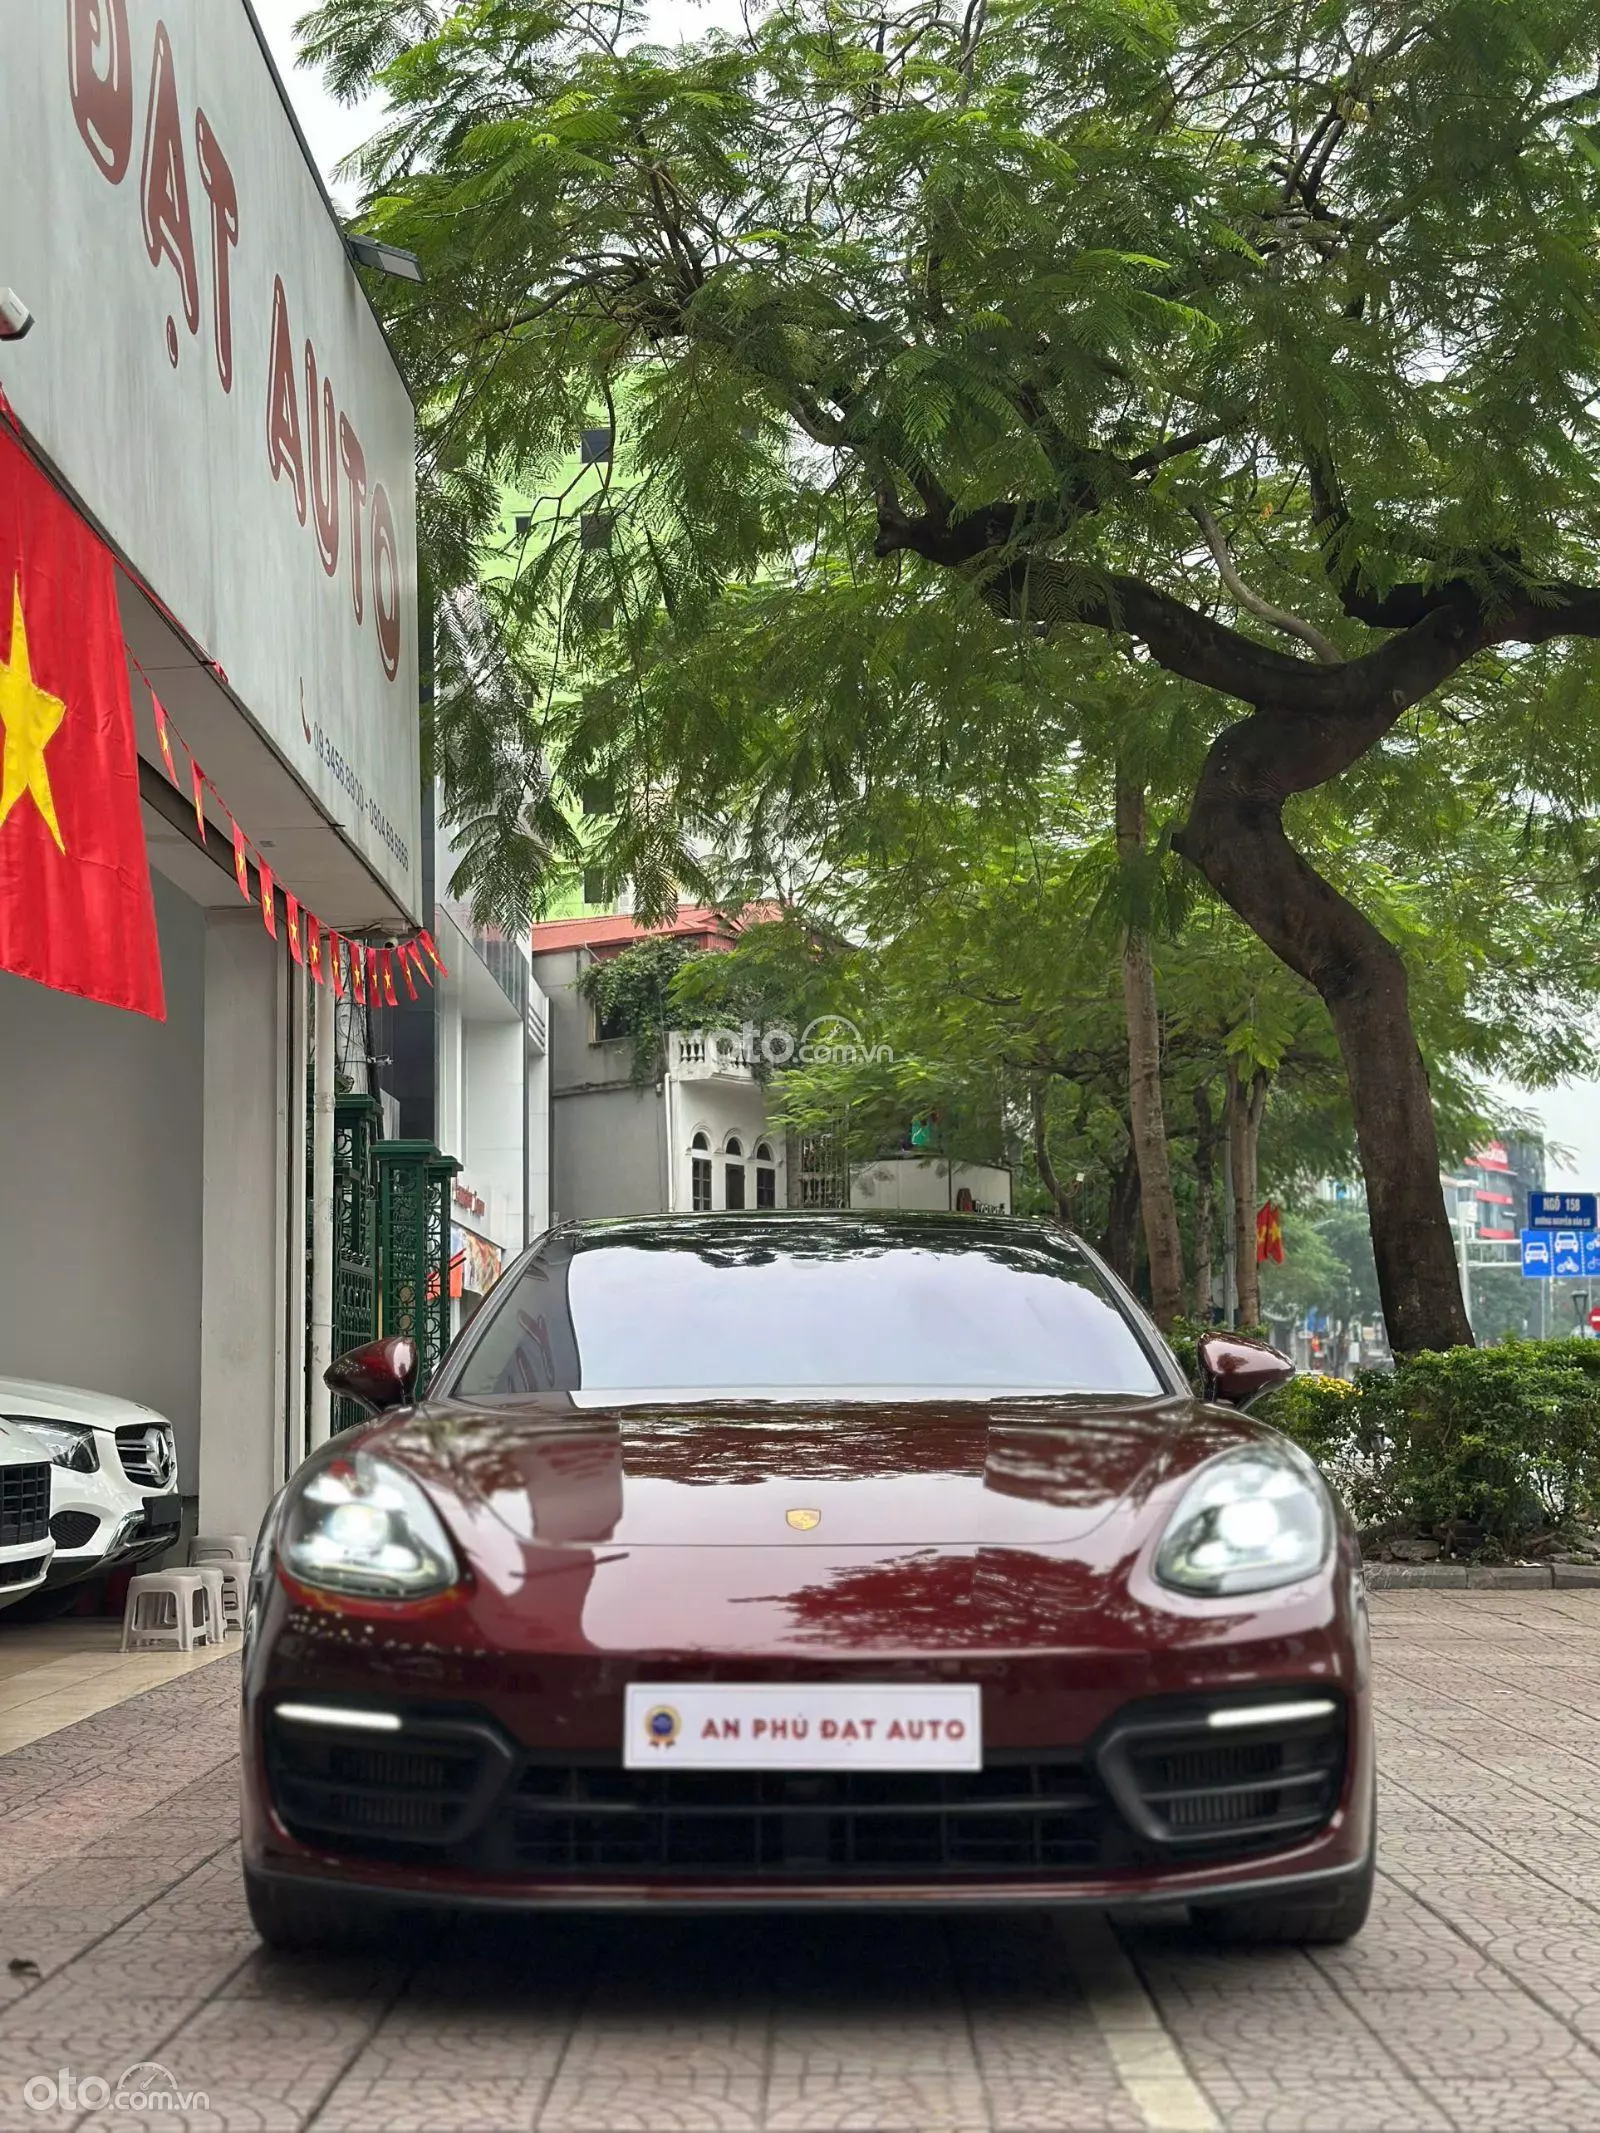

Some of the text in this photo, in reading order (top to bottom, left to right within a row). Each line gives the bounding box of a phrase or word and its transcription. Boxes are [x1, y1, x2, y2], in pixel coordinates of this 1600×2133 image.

[266, 273, 400, 683] AUTO
[701, 1719, 740, 1739] AN
[820, 1719, 877, 1746] ĐẠT
[886, 1719, 966, 1740] AUTO
